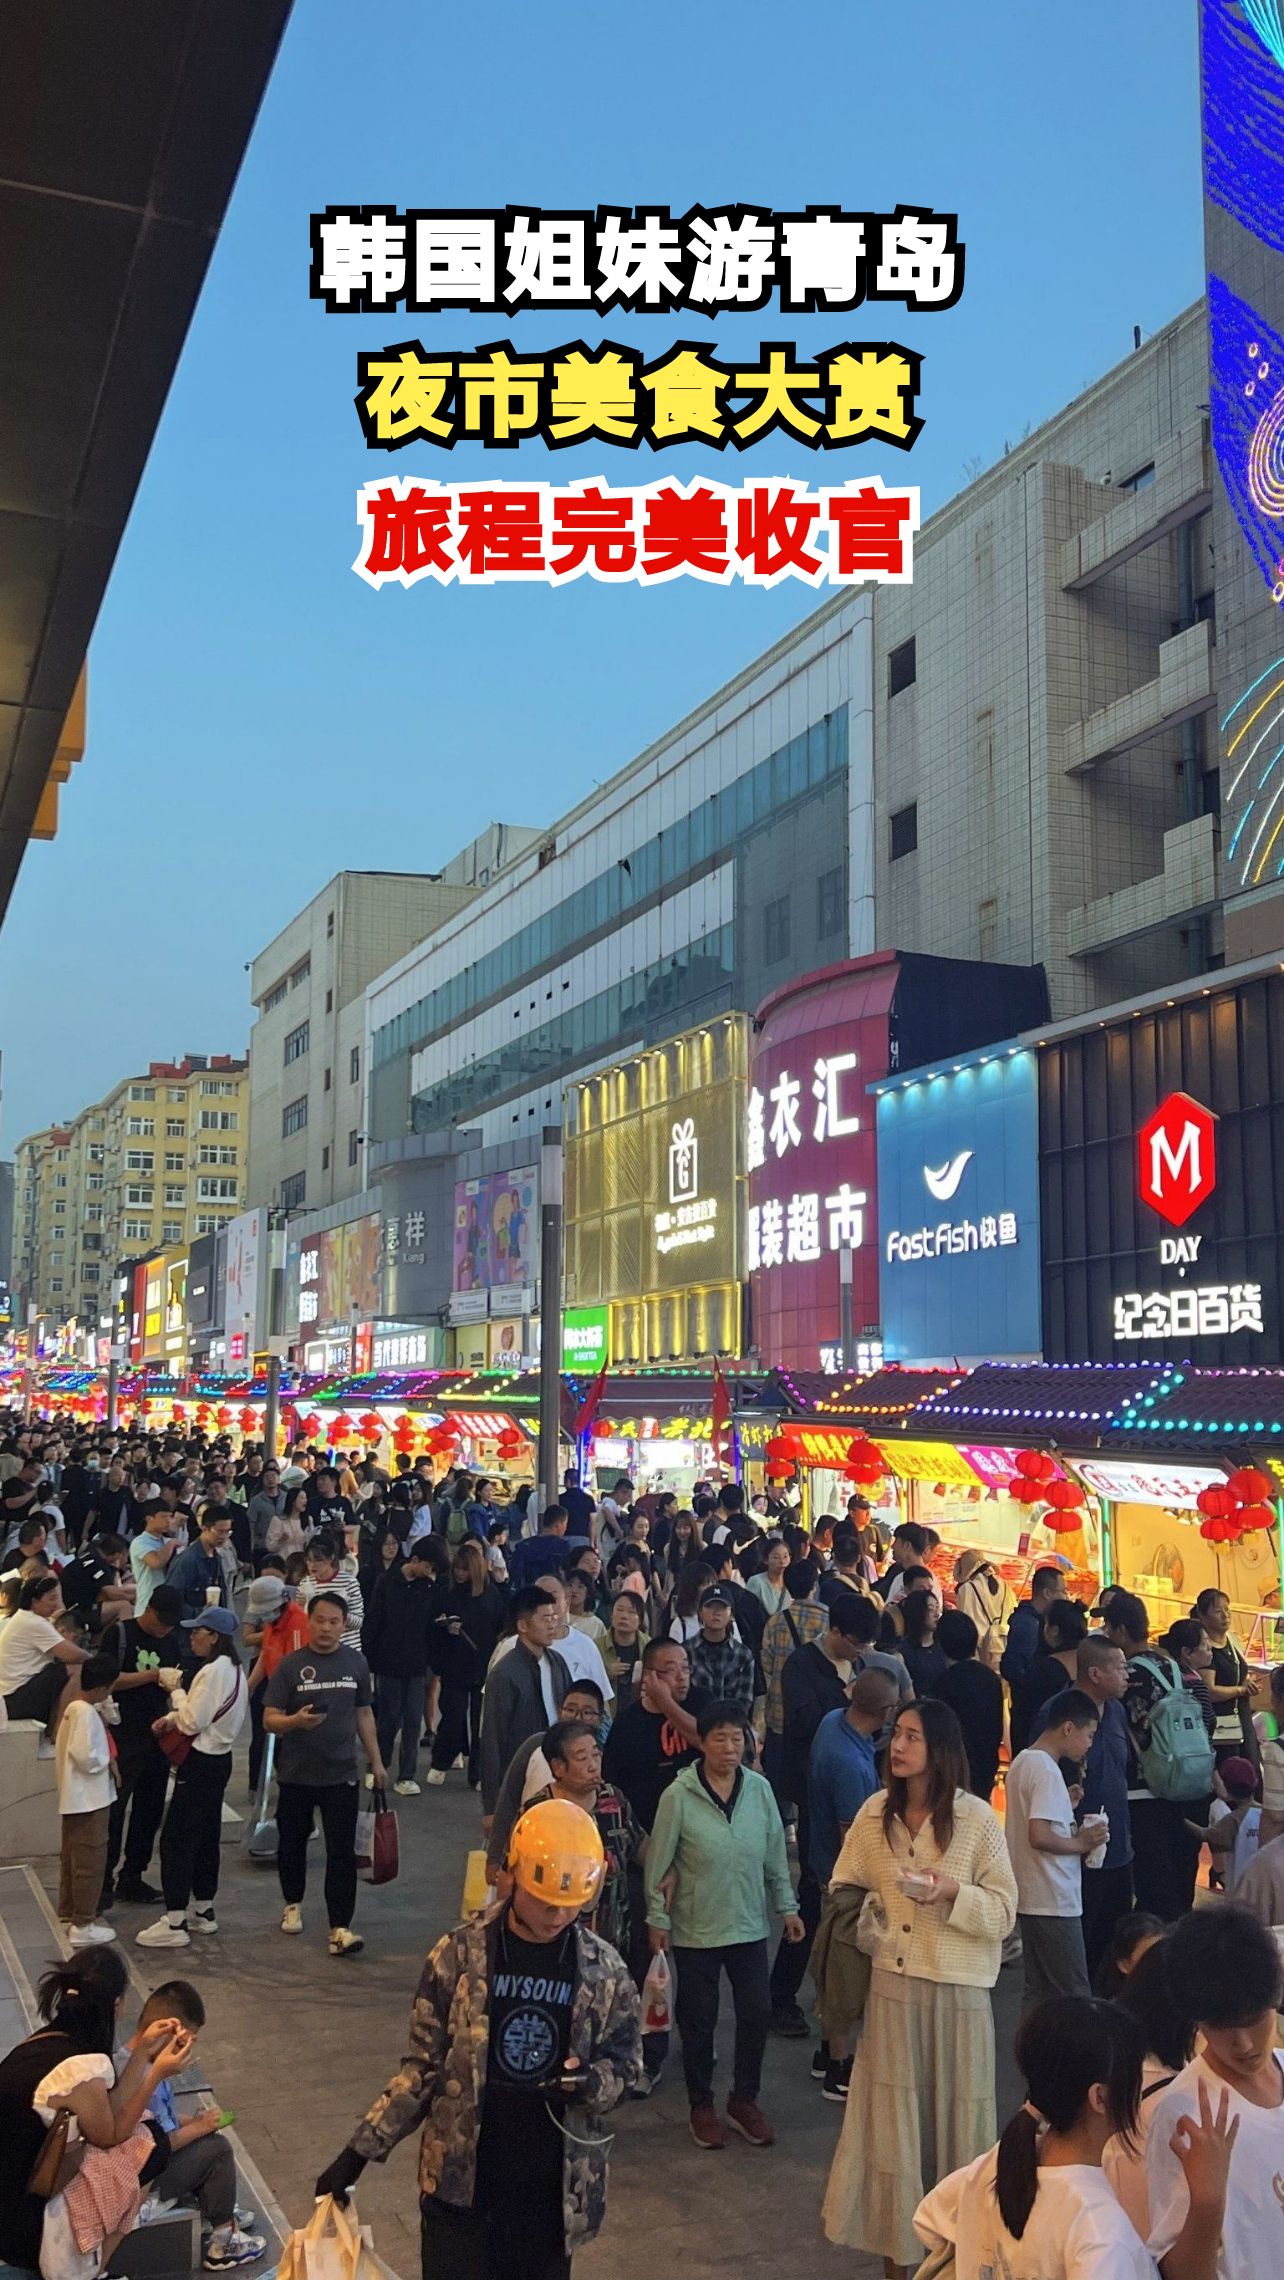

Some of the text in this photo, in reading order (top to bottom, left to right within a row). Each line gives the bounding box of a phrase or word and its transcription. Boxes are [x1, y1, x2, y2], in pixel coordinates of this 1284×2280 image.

[1149, 1120, 1202, 1198] M
[1160, 1235, 1202, 1264] DAY
[1114, 1283, 1264, 1340] 纪念日百货
